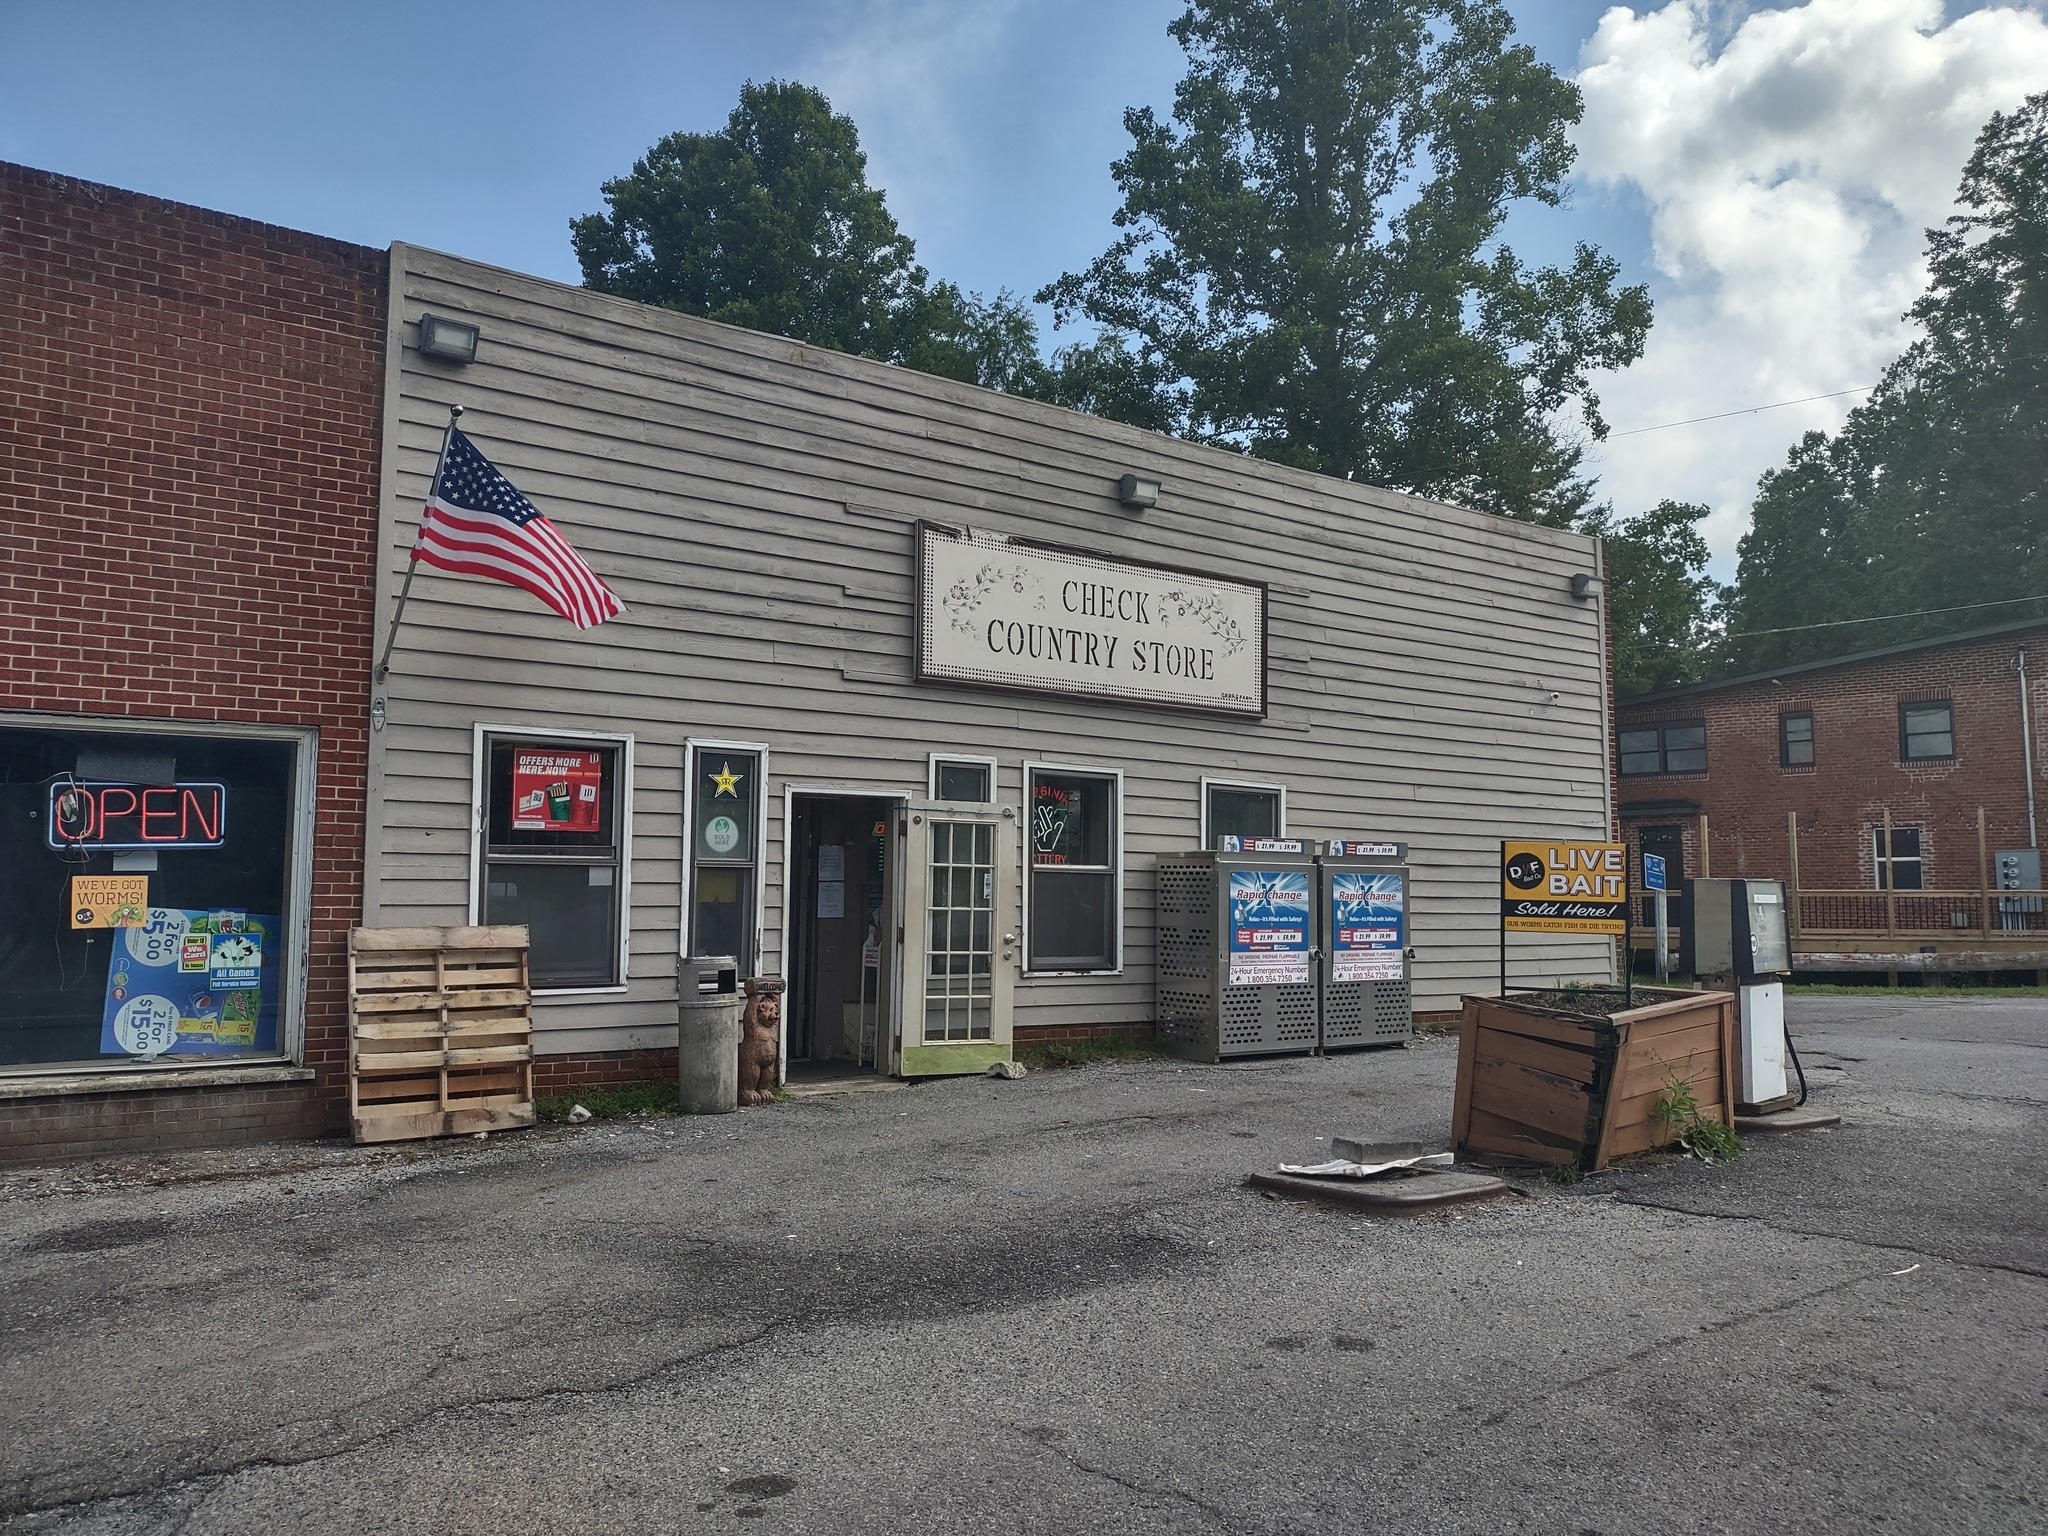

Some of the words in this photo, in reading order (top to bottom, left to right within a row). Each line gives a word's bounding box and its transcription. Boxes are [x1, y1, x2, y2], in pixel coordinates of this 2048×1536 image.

[1062, 580, 1150, 625] CHECK
[986, 618, 1119, 669] COUNTRY
[1132, 640, 1214, 680] STORE
[519, 755, 554, 766] OFFERS
[555, 758, 581, 767] MORE
[56, 788, 218, 840] OPEN
[1548, 848, 1624, 871] LIVE
[77, 880, 118, 890] WE'VE
[121, 880, 144, 890] GOT
[1548, 874, 1624, 897] BAIT
[77, 891, 143, 905] WORMS!
[1514, 902, 1560, 916] Sold
[1562, 903, 1618, 917] Here!
[167, 922, 180, 930] 2
[1543, 921, 1563, 929] CATCH
[1589, 922, 1600, 930] DIE
[142, 910, 168, 960] $5.00
[184, 951, 206, 959] Card
[242, 946, 253, 956] 3
[1231, 966, 1253, 975] 24-Hour
[1253, 966, 1284, 975] Emergency
[1334, 964, 1353, 972] 24-Hour
[1354, 964, 1381, 972] Emergency
[216, 969, 227, 978] All
[228, 969, 255, 977] Games
[1247, 974, 1293, 983] 1.800.354.7250
[153, 1010, 166, 1019] 2
[131, 999, 153, 1050] $15.00
[202, 1020, 213, 1030] 15
[240, 1022, 250, 1033] 15
